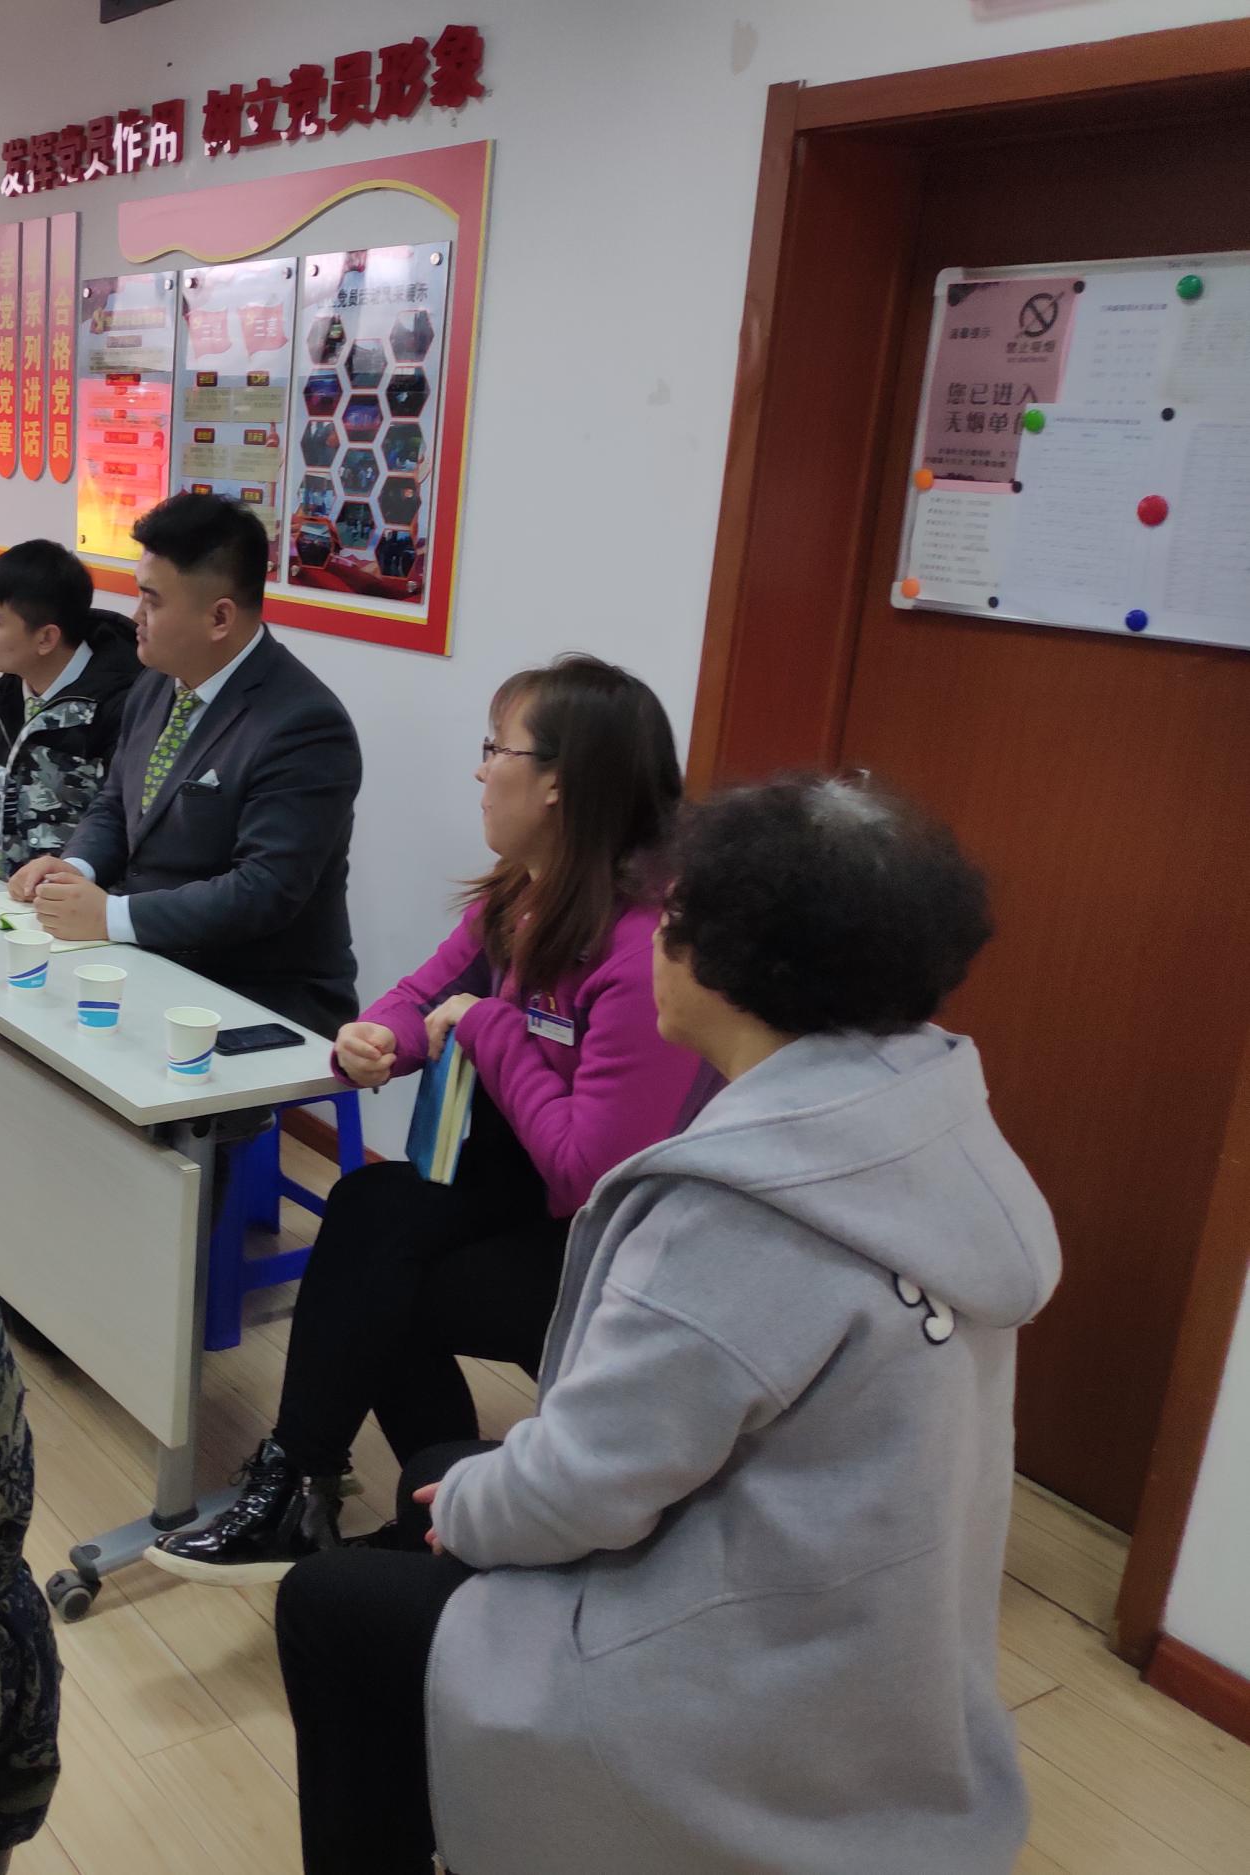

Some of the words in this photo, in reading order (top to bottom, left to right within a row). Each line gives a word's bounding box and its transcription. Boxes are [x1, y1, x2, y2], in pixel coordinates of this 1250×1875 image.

[203, 23, 486, 158] 树立党员形象
[0, 98, 185, 198] 发挥党员作用
[946, 382, 1040, 406] 您已进入
